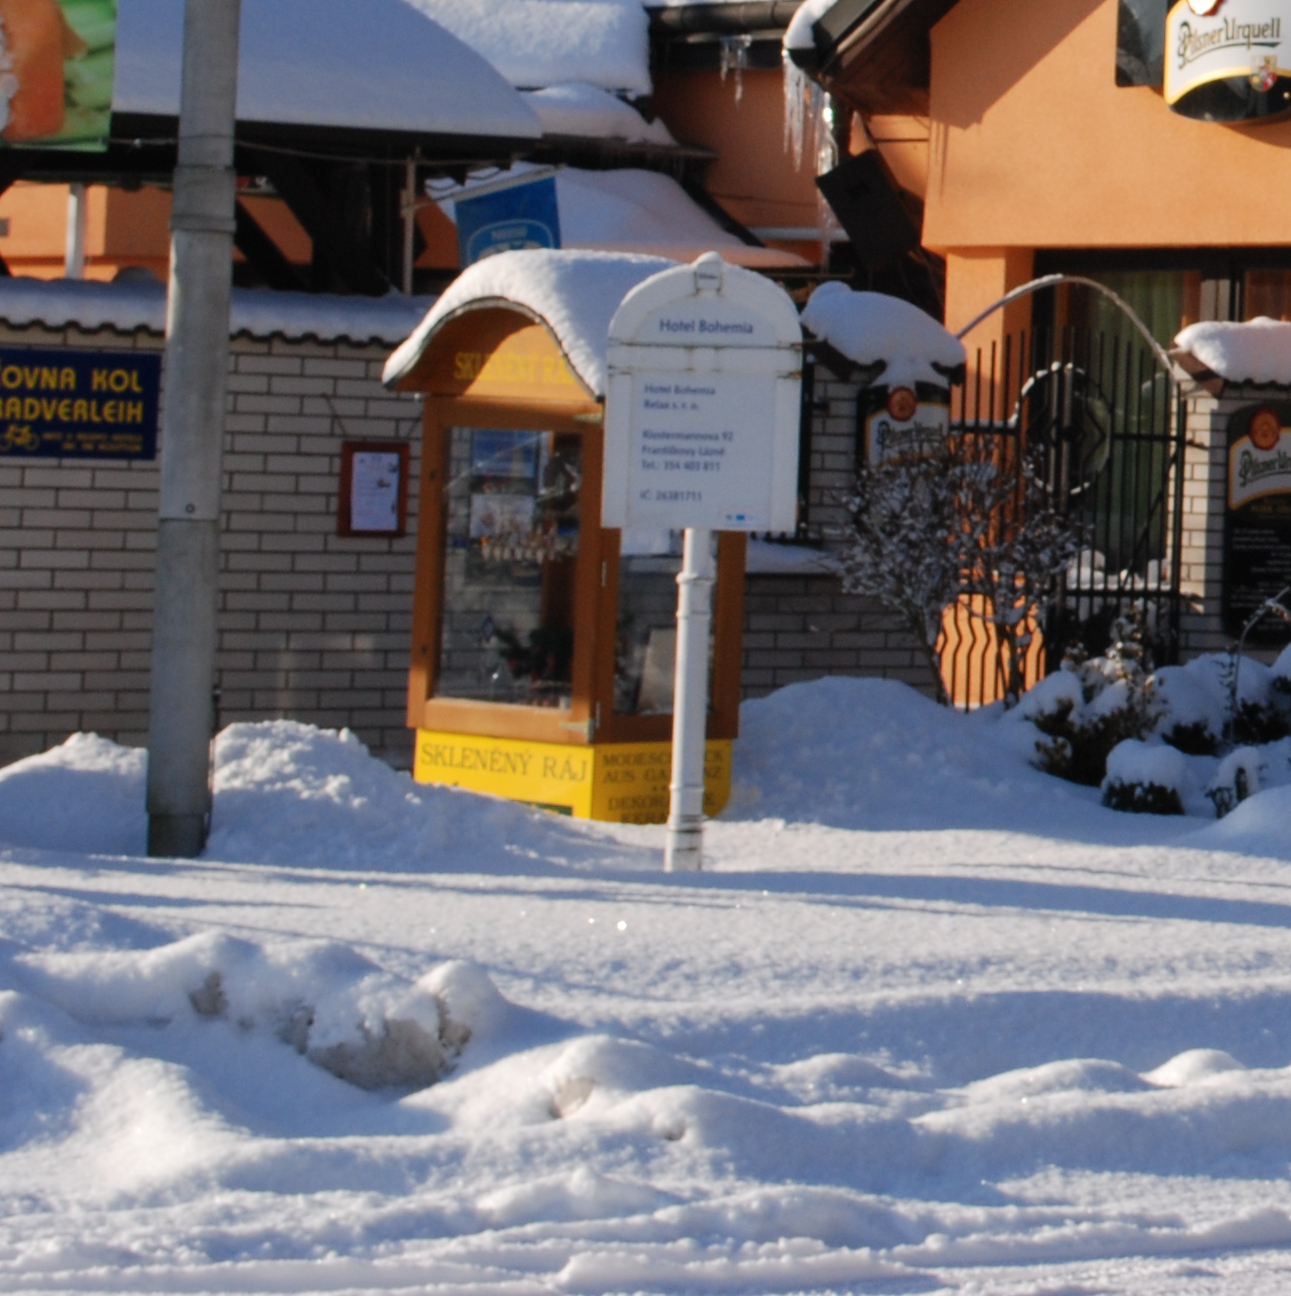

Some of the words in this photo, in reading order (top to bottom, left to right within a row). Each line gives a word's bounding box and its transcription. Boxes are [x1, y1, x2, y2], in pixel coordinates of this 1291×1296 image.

[1177, 20, 1223, 70] Pilsner
[1223, 15, 1282, 51] Urquell
[659, 318, 695, 332] Hotel
[699, 319, 754, 334] Bohemia
[0, 364, 77, 391] OVNA
[92, 368, 144, 393] KOL
[674, 384, 716, 396] Bohemia
[0, 396, 144, 424] ADVERLEIH
[542, 754, 588, 782] RÁJ
